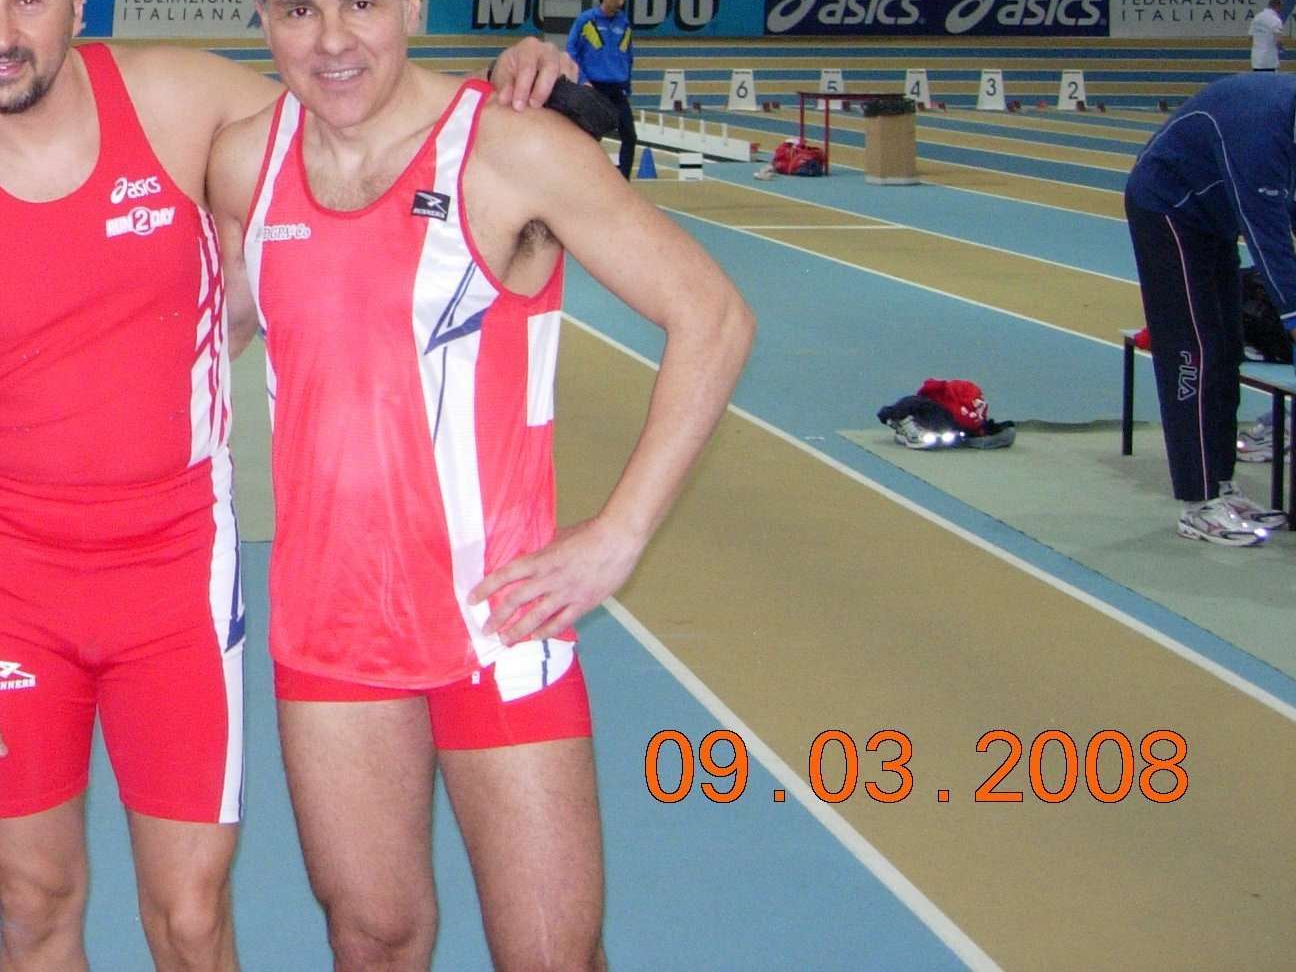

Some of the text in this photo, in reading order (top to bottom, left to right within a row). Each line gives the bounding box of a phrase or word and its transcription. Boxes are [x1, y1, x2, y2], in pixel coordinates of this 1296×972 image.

[122, 7, 242, 21] ITALIANA
[1121, 8, 1254, 22] ITALIANA
[669, 81, 679, 99] 7
[736, 80, 748, 99] 6
[910, 80, 921, 97] 4
[985, 78, 997, 97] 3
[1067, 81, 1079, 100] 2
